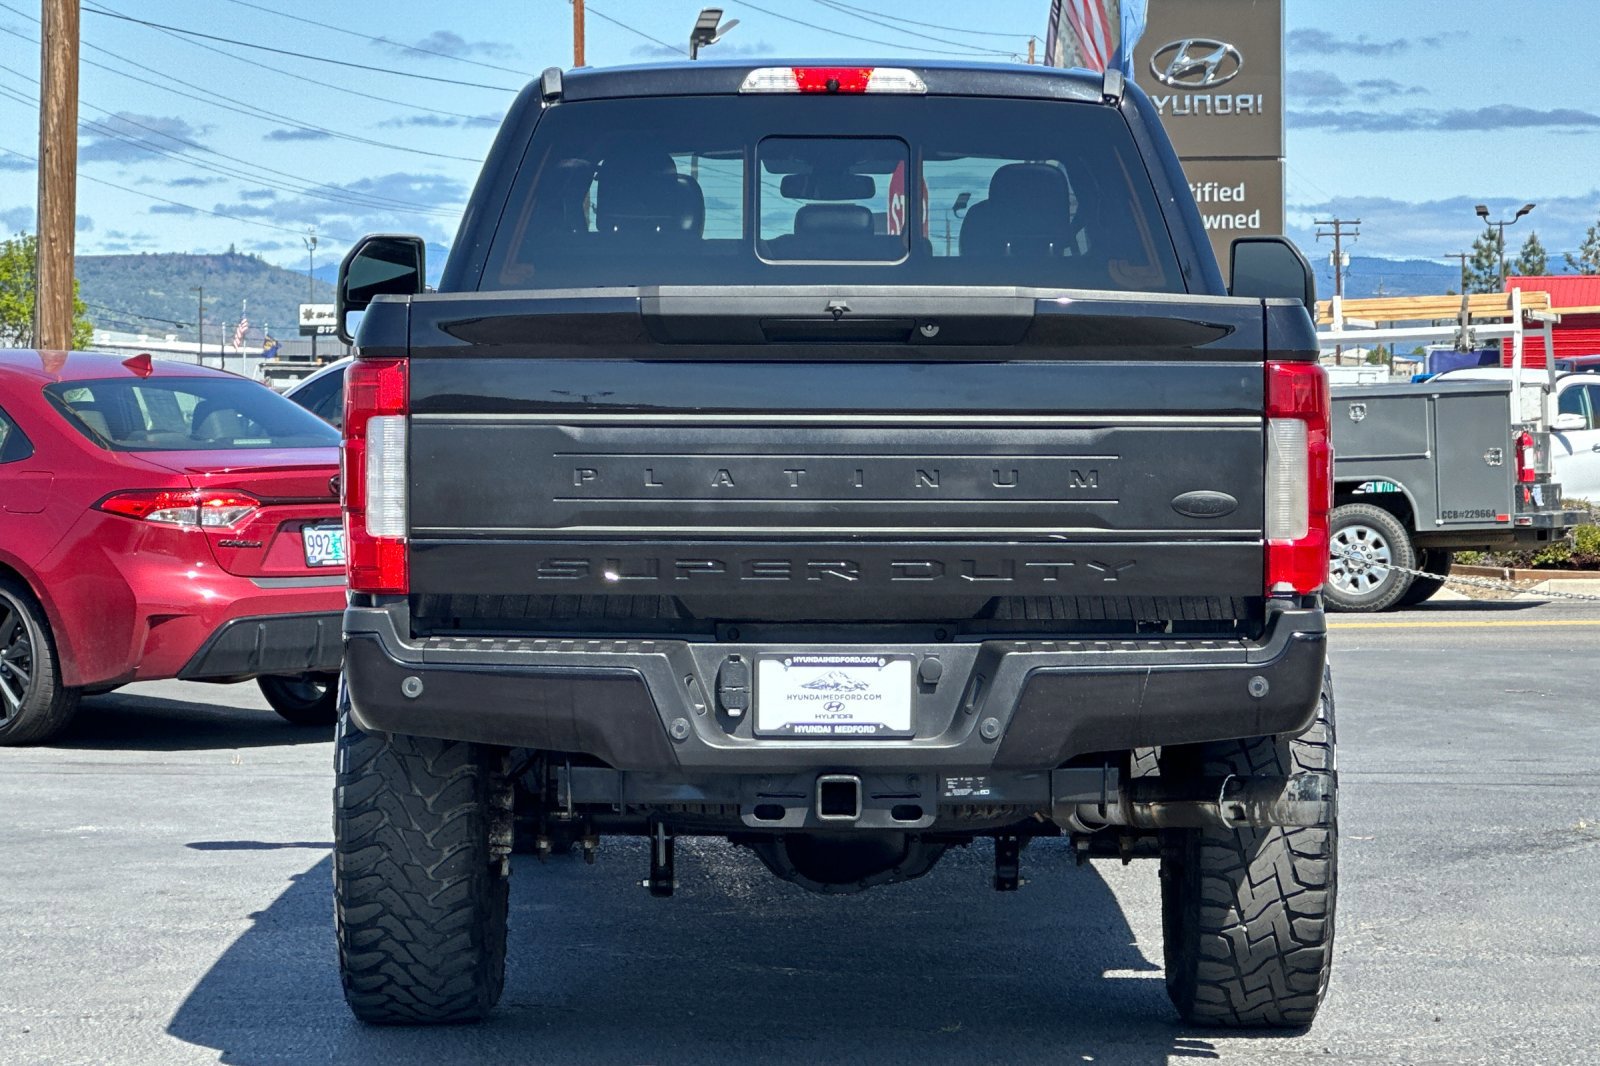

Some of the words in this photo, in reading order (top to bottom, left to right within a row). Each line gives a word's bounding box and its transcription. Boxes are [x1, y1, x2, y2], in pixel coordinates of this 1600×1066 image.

[1148, 94, 1263, 115] YUNDAI
[1202, 209, 1260, 230] wned
[574, 468, 1098, 488] PLATINUM
[1441, 509, 1497, 520] CCB#229664
[305, 534, 334, 556] 992
[537, 557, 860, 581] SUPER
[891, 558, 1137, 582] DUTY
[793, 656, 878, 664] HYUNDAIMEDFORD.COM
[794, 725, 832, 734] HYUNDAI
[834, 725, 876, 734] MEDFORD
